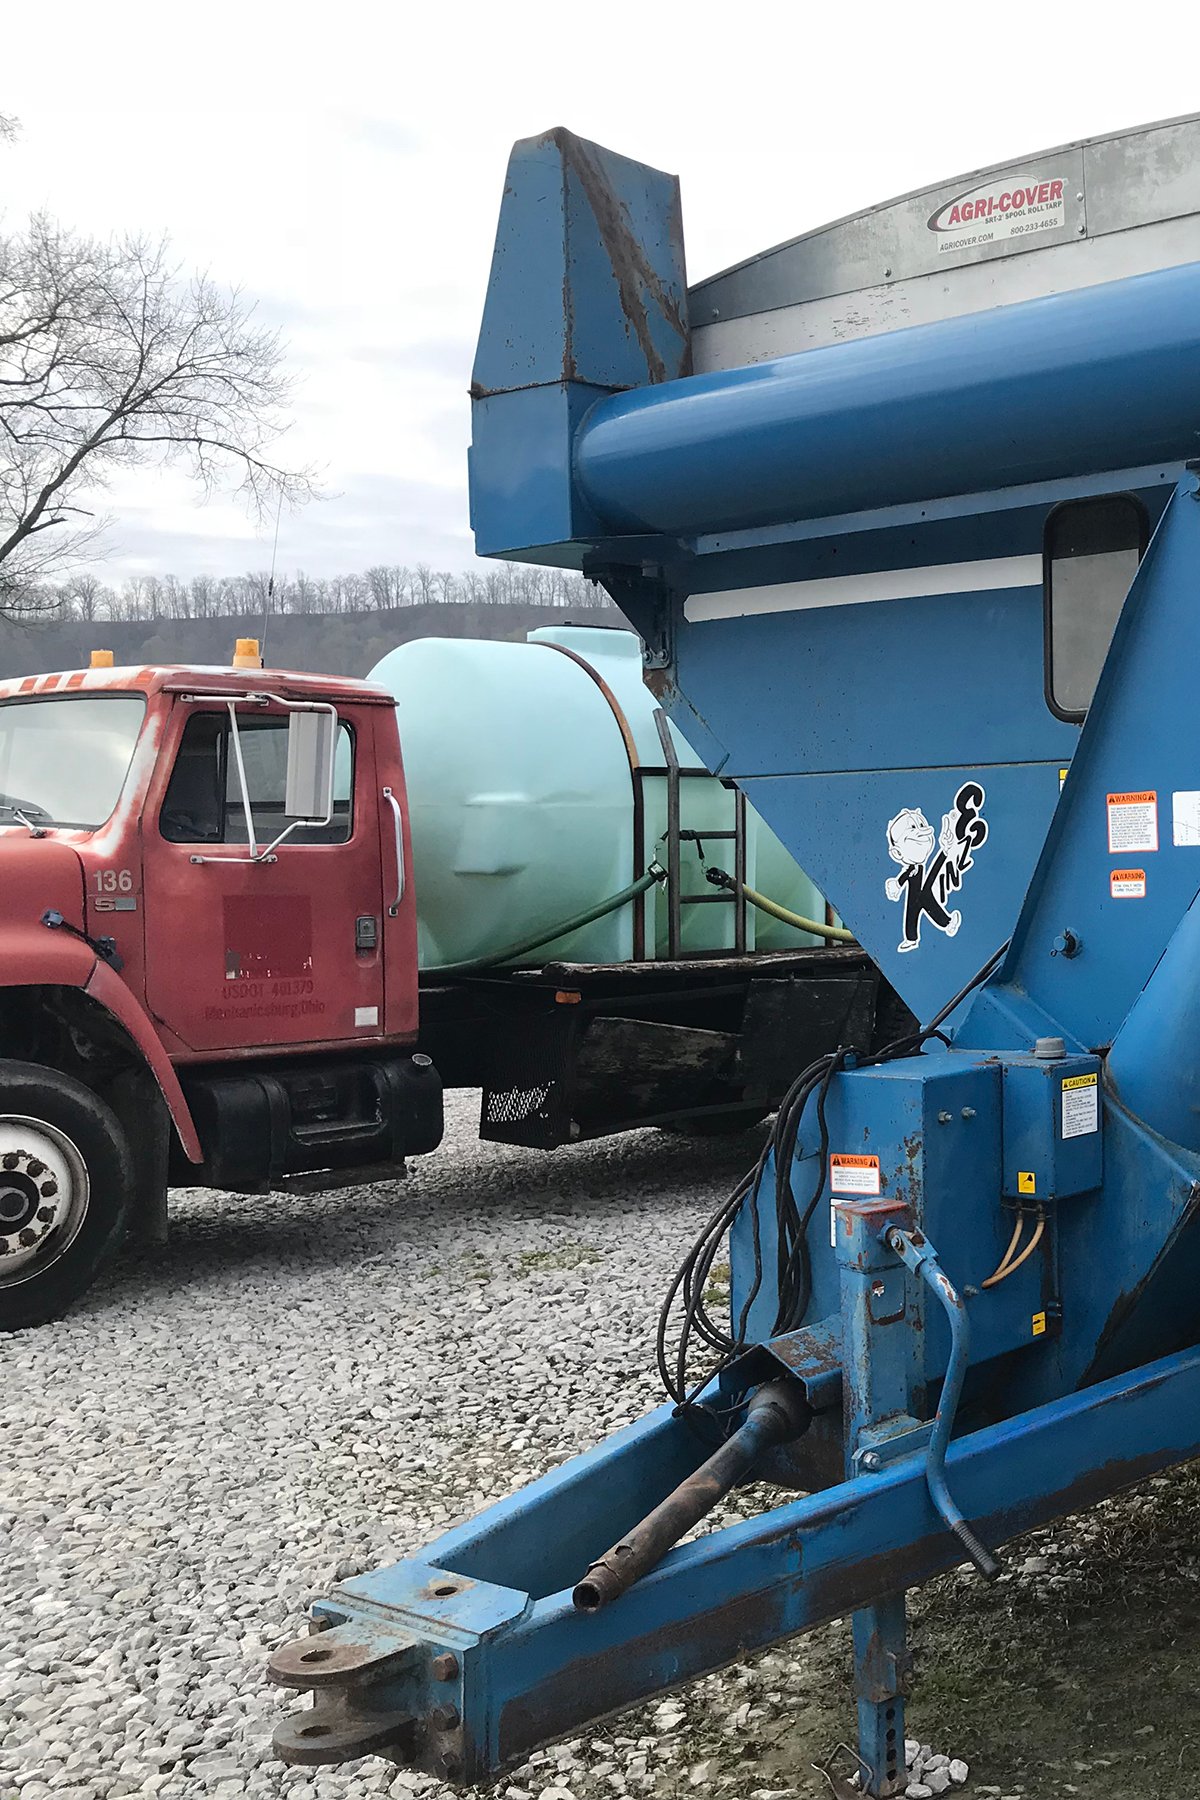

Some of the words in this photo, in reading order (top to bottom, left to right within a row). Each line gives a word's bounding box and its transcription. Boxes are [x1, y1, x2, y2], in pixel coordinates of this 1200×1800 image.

[948, 180, 1063, 225] AGRI-COVER
[1005, 209, 1026, 220] SPOOL
[1027, 205, 1045, 215] ROLL
[1045, 200, 1063, 211] TARP
[1010, 217, 1058, 236] 800-233-4655
[939, 232, 994, 252] AGRICOVER.COM
[1115, 793, 1148, 802] WARNING
[93, 869, 132, 892] 136
[1119, 871, 1145, 880] WARNING
[221, 983, 264, 1000] USDOT
[1068, 1076, 1091, 1088] CAUTION
[840, 1157, 869, 1165] WARNING
